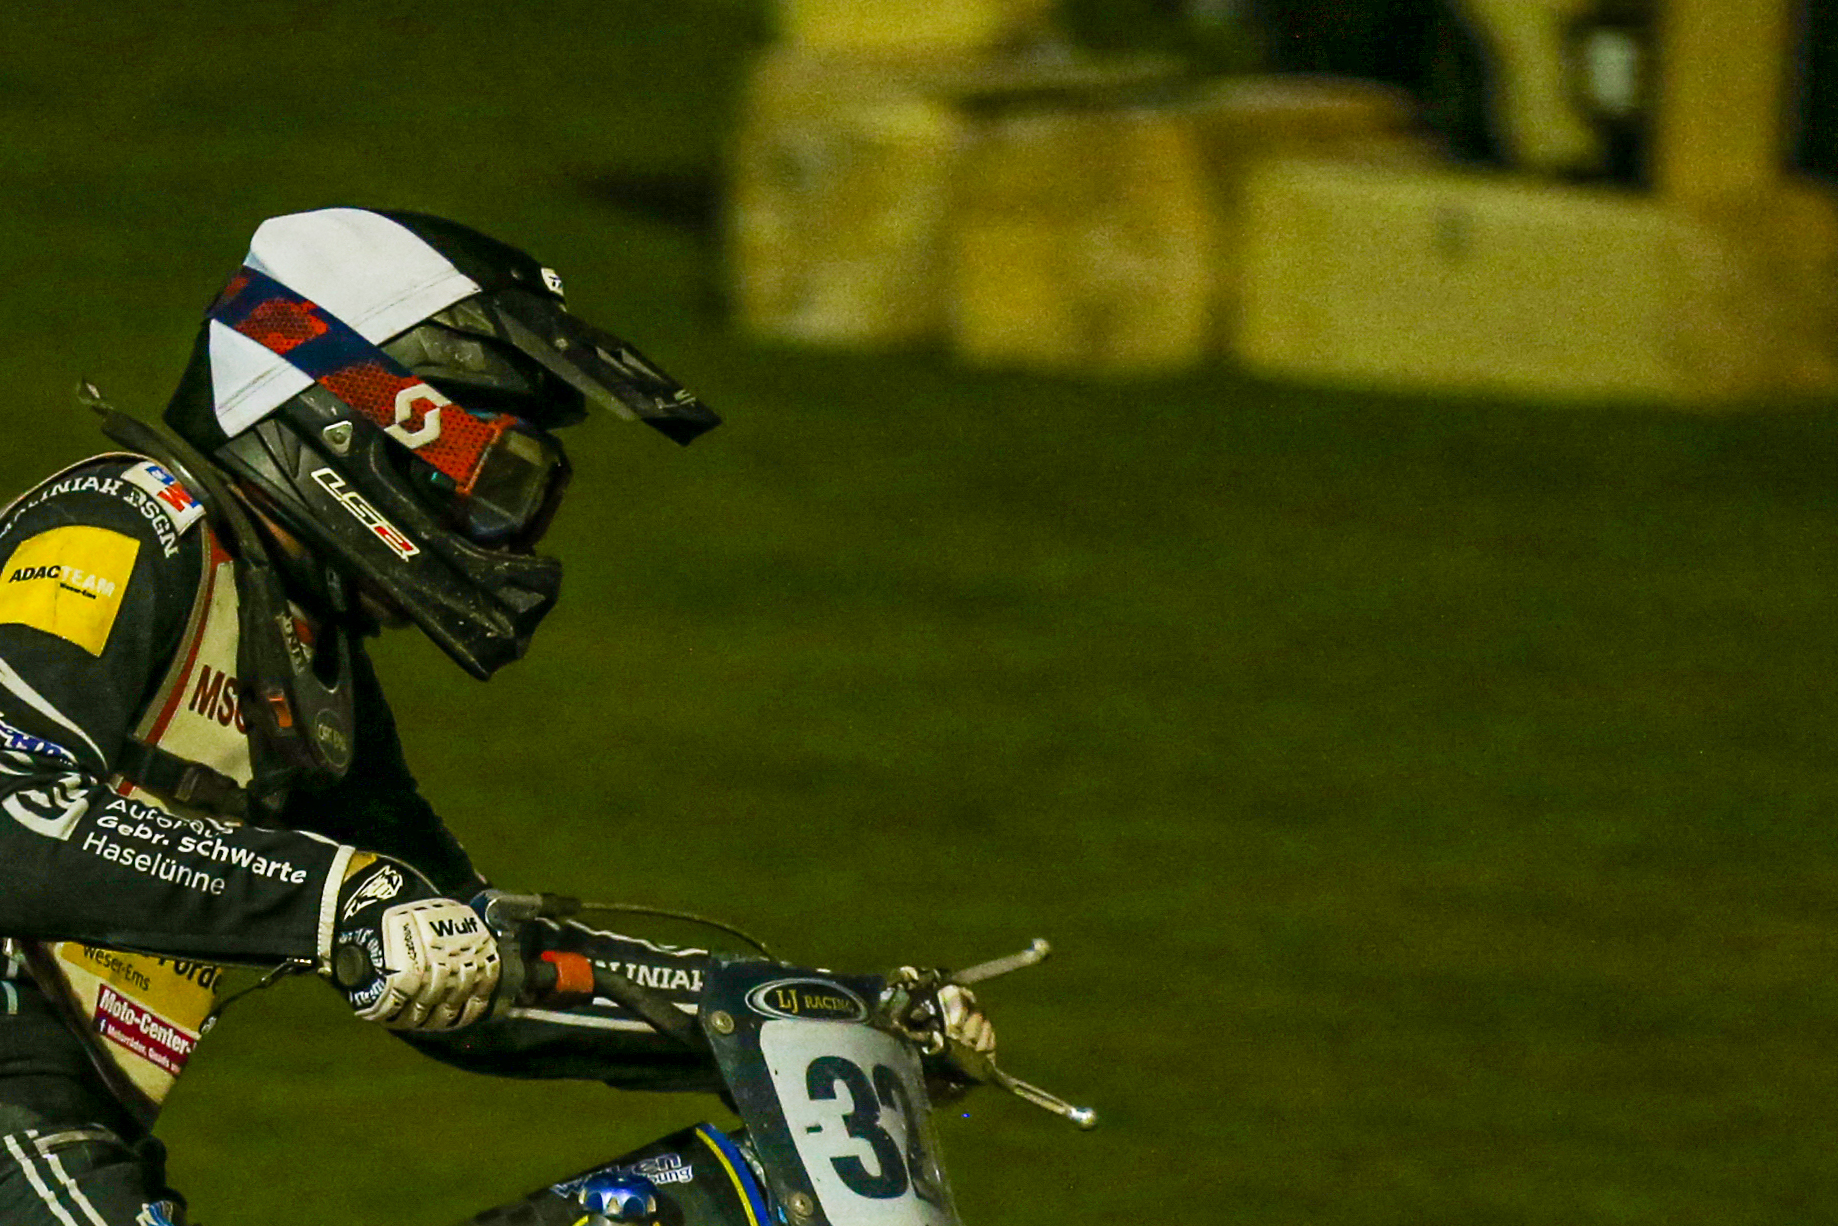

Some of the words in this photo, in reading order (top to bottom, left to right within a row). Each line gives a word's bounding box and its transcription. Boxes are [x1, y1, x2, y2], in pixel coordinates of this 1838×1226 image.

[8, 565, 61, 583] ADAC
[61, 565, 116, 597] TEAM
[97, 815, 170, 846] Gebr.
[82, 832, 226, 895] Haselünne
[429, 917, 479, 937] Wulf
[776, 989, 799, 1014] LJ
